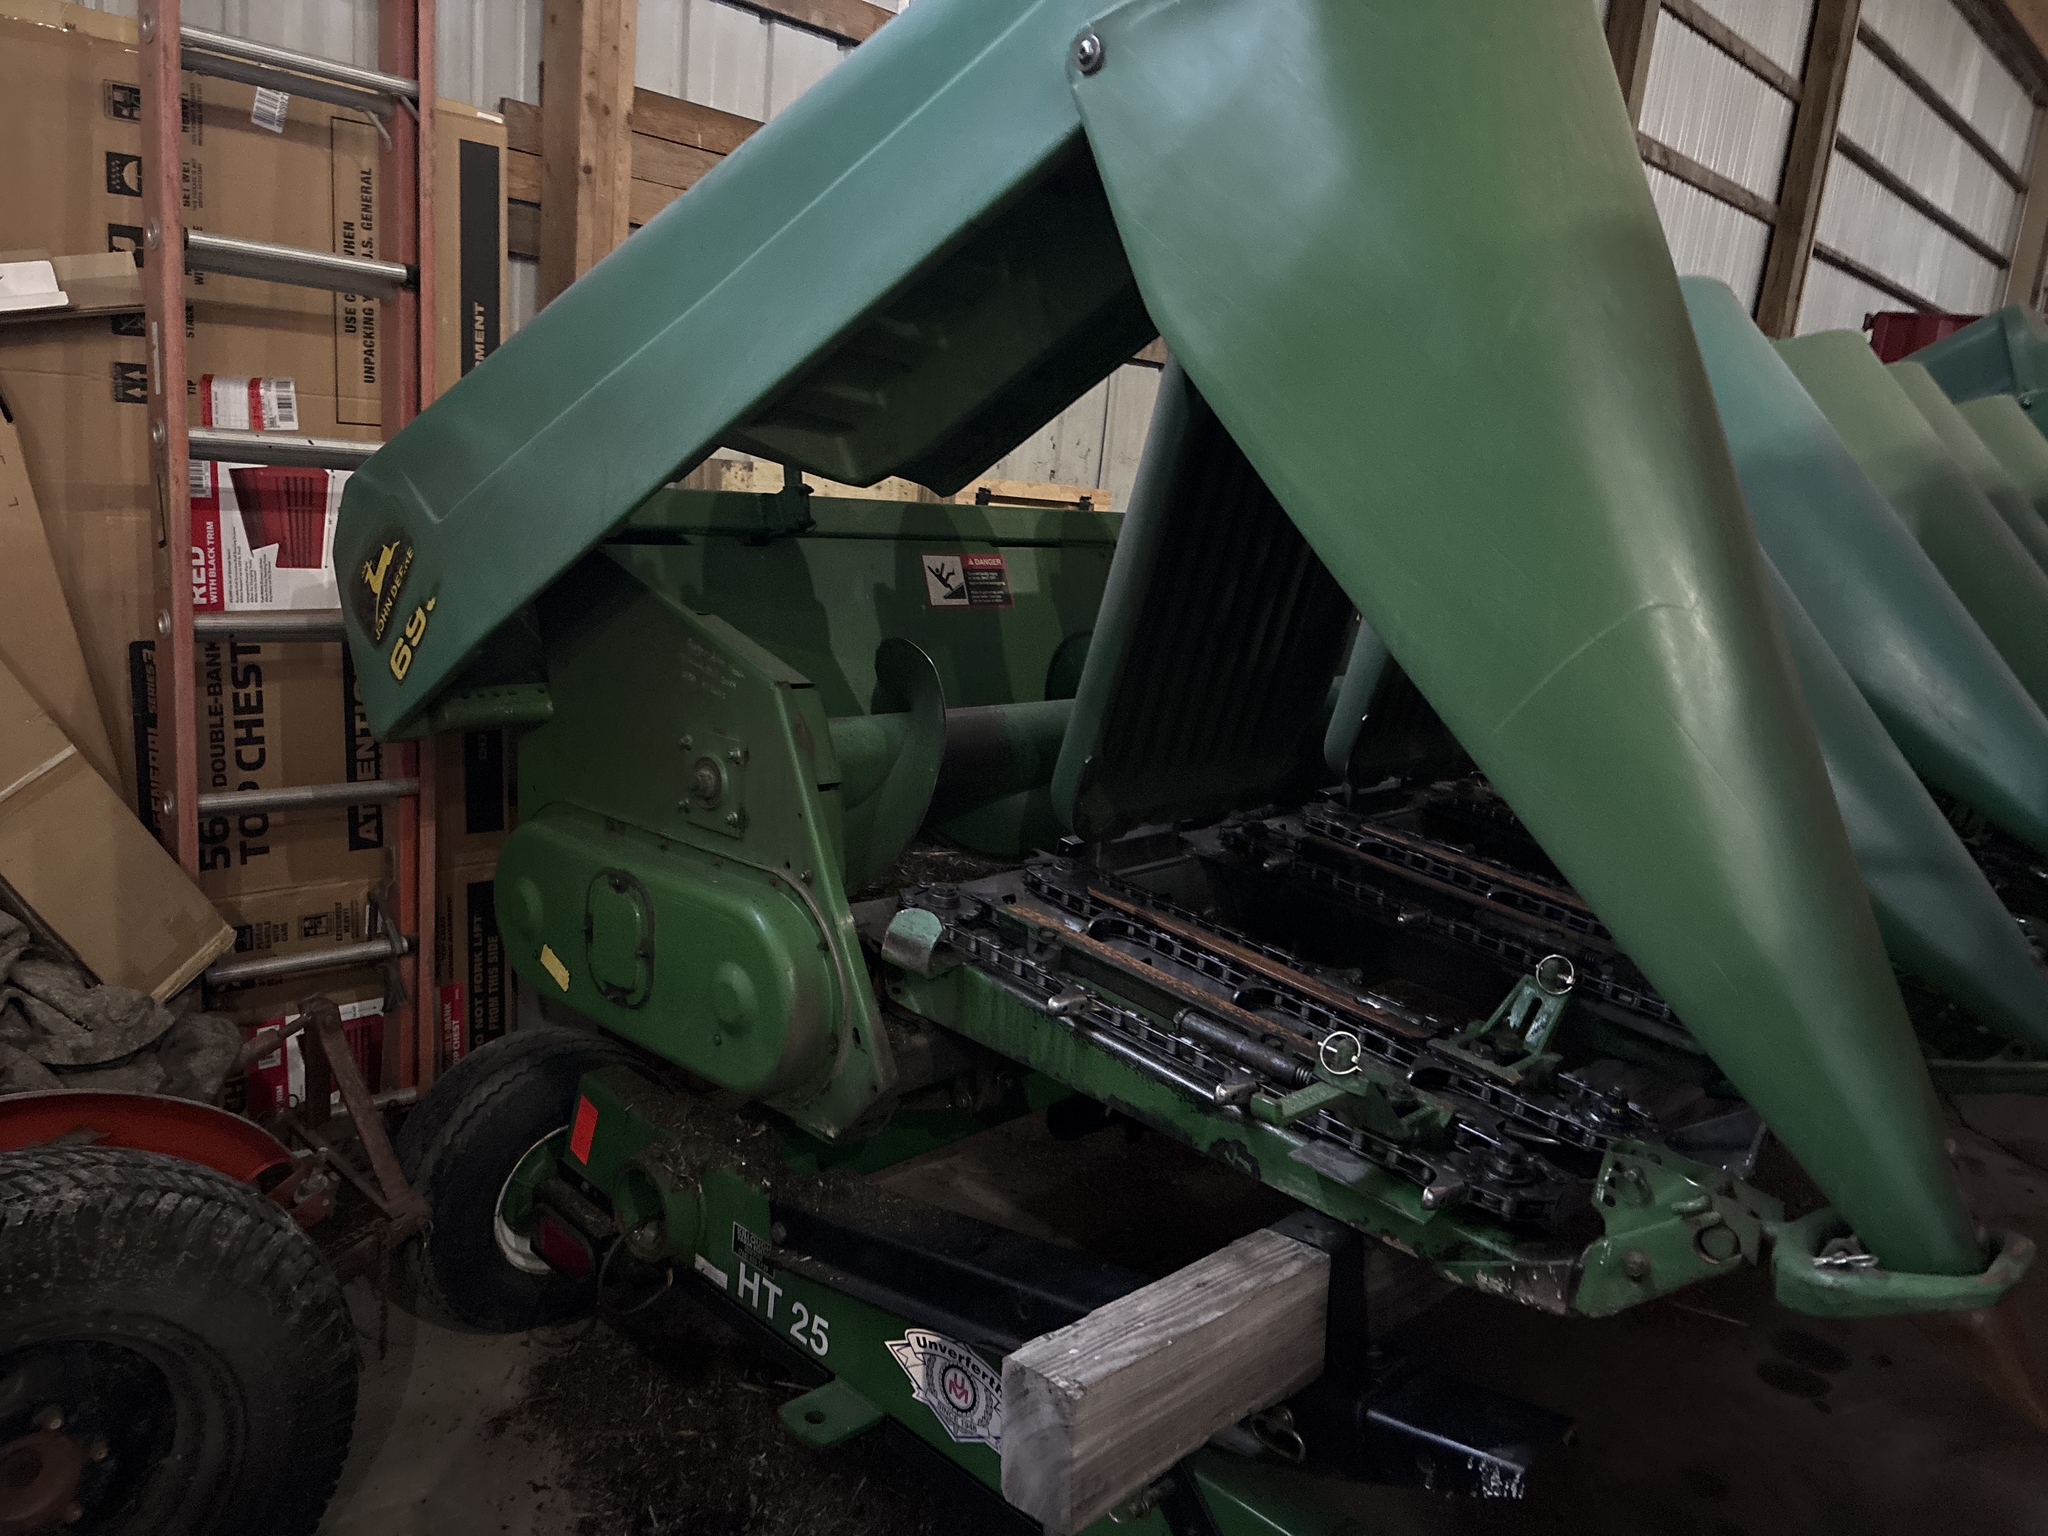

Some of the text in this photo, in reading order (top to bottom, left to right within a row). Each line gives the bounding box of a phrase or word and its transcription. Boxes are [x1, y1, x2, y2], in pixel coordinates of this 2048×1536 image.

[360, 168, 372, 230] GENERAL
[345, 307, 357, 334] USE
[363, 307, 375, 383] UNPACKING
[187, 380, 197, 395] TIP
[191, 547, 207, 605] RED
[206, 521, 218, 604] WITH BLACK TRIM
[974, 558, 1002, 566] DANGER
[376, 546, 414, 641] JOHN DEERE
[230, 642, 266, 771] CHEST
[199, 641, 231, 871] 56 DOUBLE-BANK
[473, 915, 482, 946] LIFT
[474, 951, 483, 992] FORK
[488, 936, 500, 1030] FROM THIS SIDE
[452, 1020, 460, 1048] CHEST
[474, 998, 483, 1028] NOT
[738, 1262, 830, 1357] HT 25
[916, 1336, 1002, 1397] Unverferth
